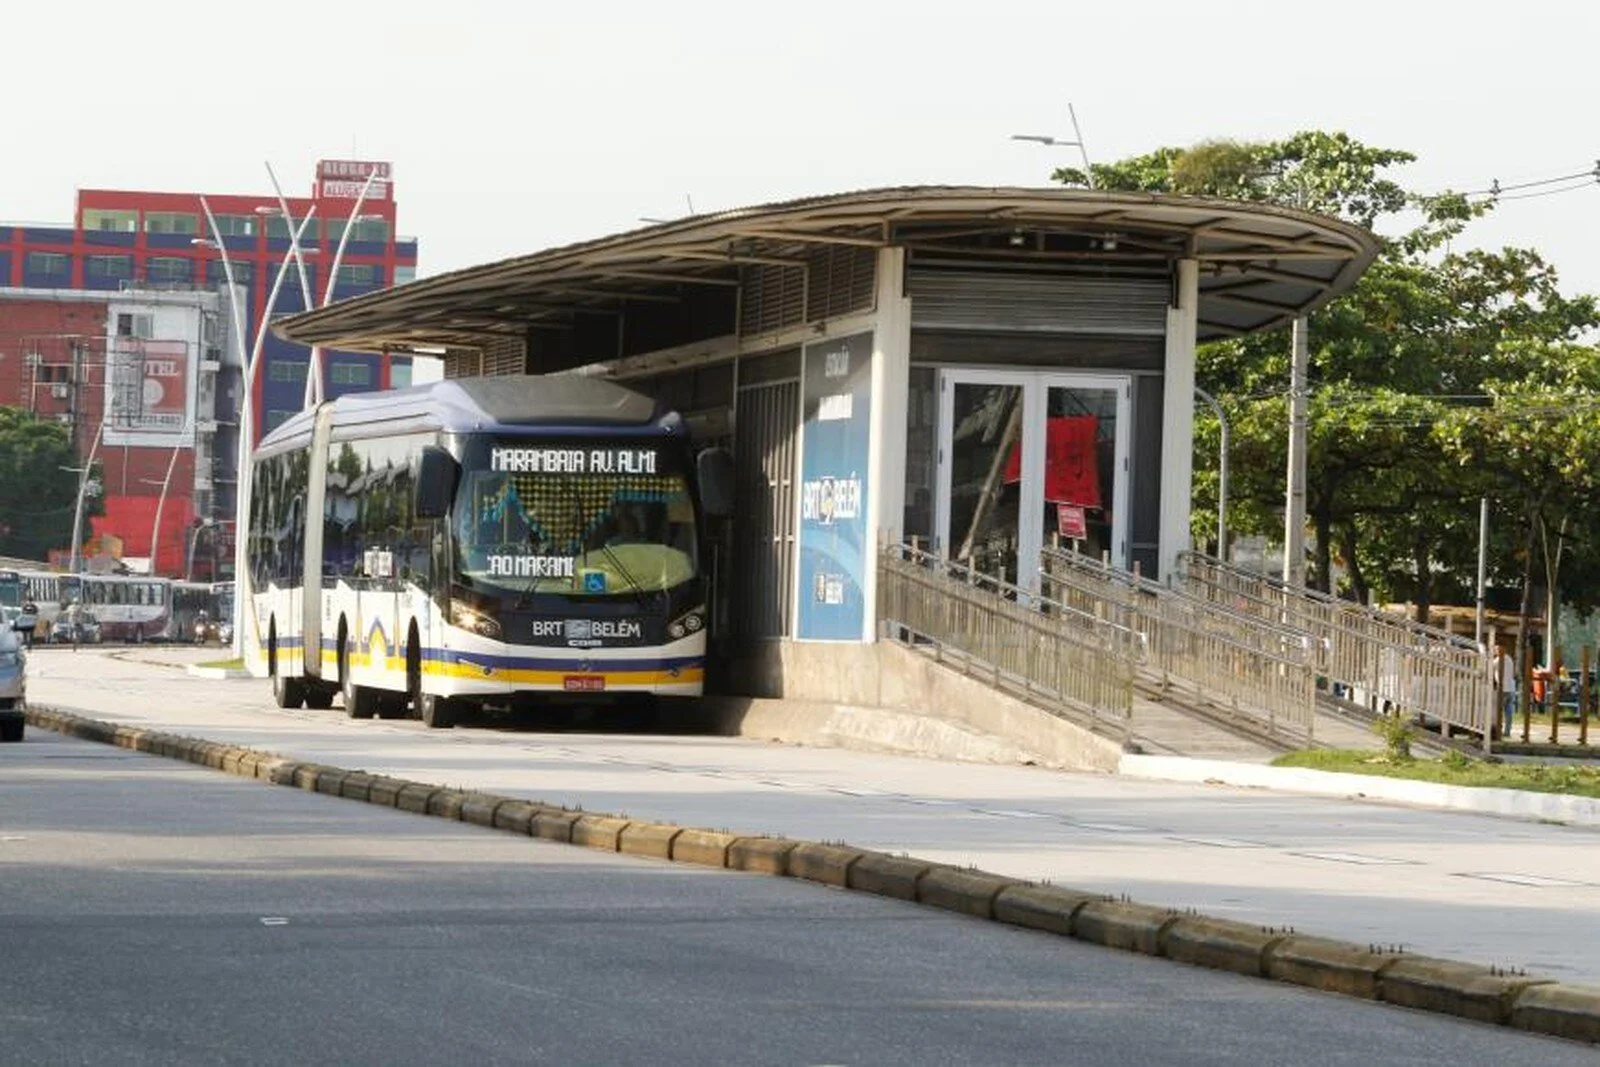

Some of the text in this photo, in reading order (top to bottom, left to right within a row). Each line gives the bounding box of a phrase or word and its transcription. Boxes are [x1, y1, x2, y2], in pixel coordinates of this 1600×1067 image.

[491, 448, 585, 472] MARAMBAIA
[590, 450, 615, 472] AV.
[532, 619, 641, 638] BRT BELÉM
